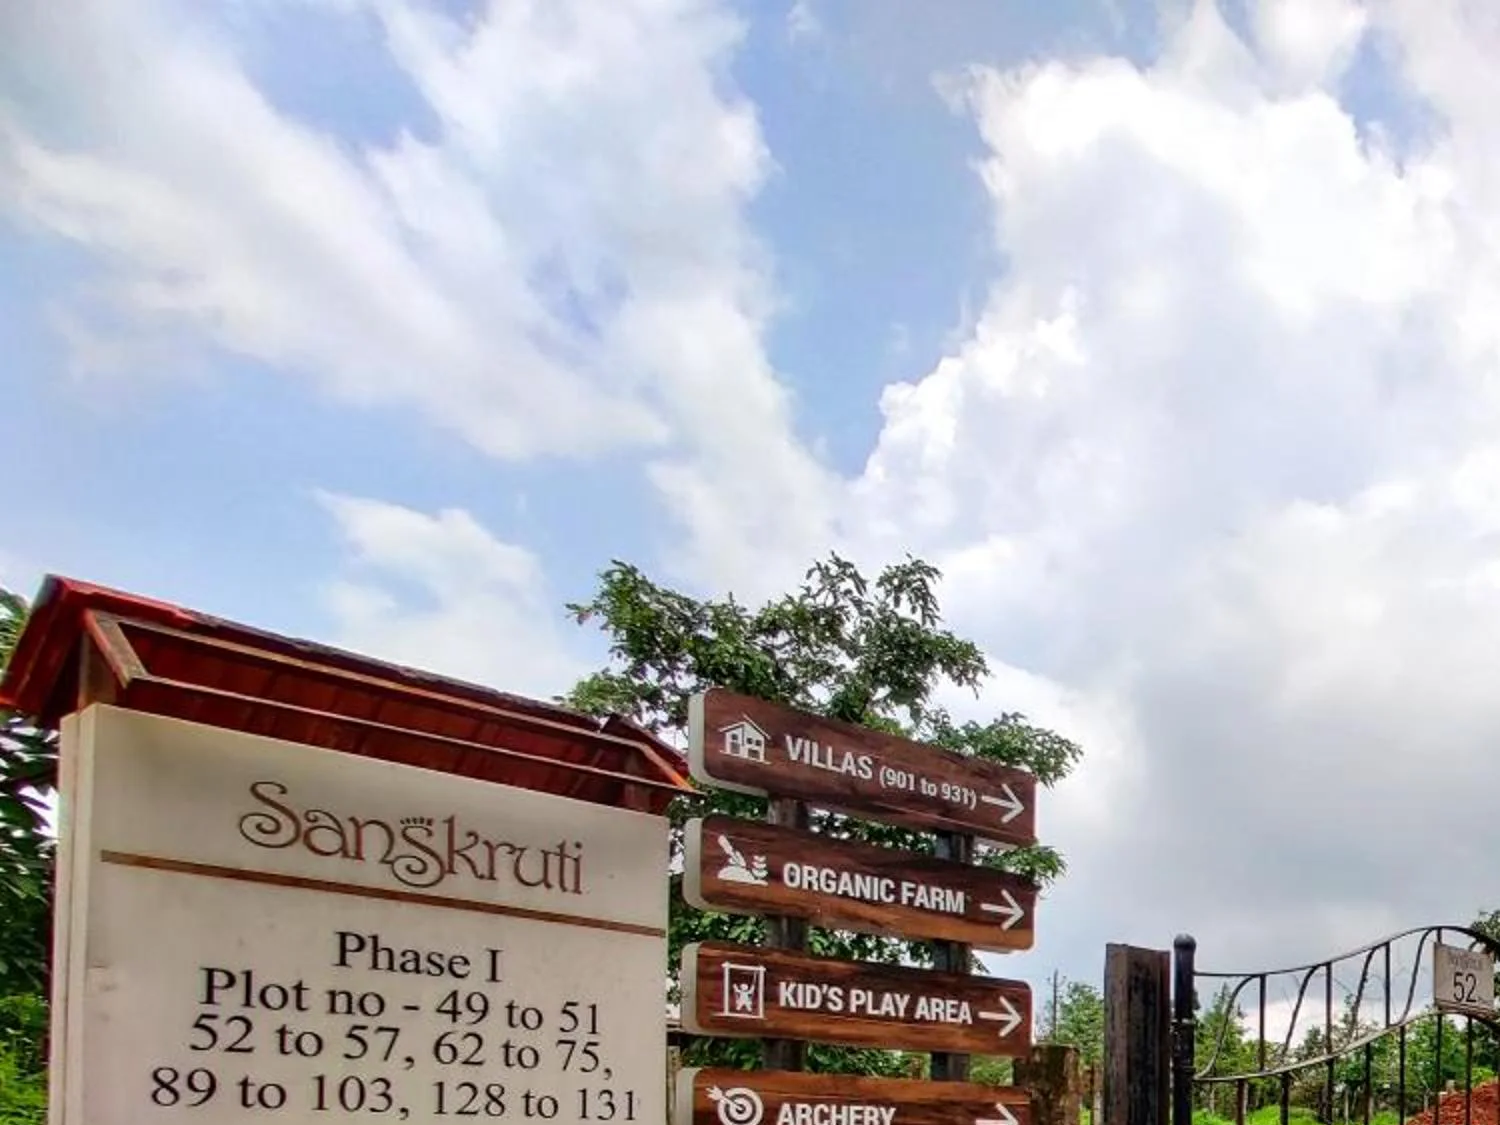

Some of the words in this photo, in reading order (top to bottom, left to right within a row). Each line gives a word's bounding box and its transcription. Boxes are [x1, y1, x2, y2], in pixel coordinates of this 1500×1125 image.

[785, 734, 873, 780] VILLAS
[879, 765, 915, 791] (901
[920, 777, 937, 796] to
[942, 785, 977, 810] 931)
[239, 781, 583, 895] Sanskruti
[783, 862, 895, 901] ORGANIC
[902, 881, 965, 915] FARM
[334, 931, 470, 979] Phase
[484, 949, 503, 983] I
[201, 967, 310, 1011] Plot
[326, 988, 386, 1018] no
[435, 990, 489, 1025] 49
[505, 1001, 544, 1031] to
[558, 1002, 599, 1034] 51
[778, 981, 844, 1012] KID'S
[850, 988, 909, 1018] PLAY
[915, 994, 972, 1025] AREA
[1453, 971, 1477, 1003] 52
[190, 1013, 254, 1053] 52
[275, 1021, 324, 1056] to
[343, 1025, 415, 1070] 57,
[432, 1030, 486, 1066] 62
[501, 1037, 540, 1070] to
[556, 1039, 613, 1080] 75,
[151, 1067, 217, 1107] 89
[238, 1074, 287, 1109] to
[313, 1074, 409, 1121] 103,
[434, 1081, 506, 1117] 128
[521, 1087, 560, 1120] to
[578, 1089, 636, 1122] 131
